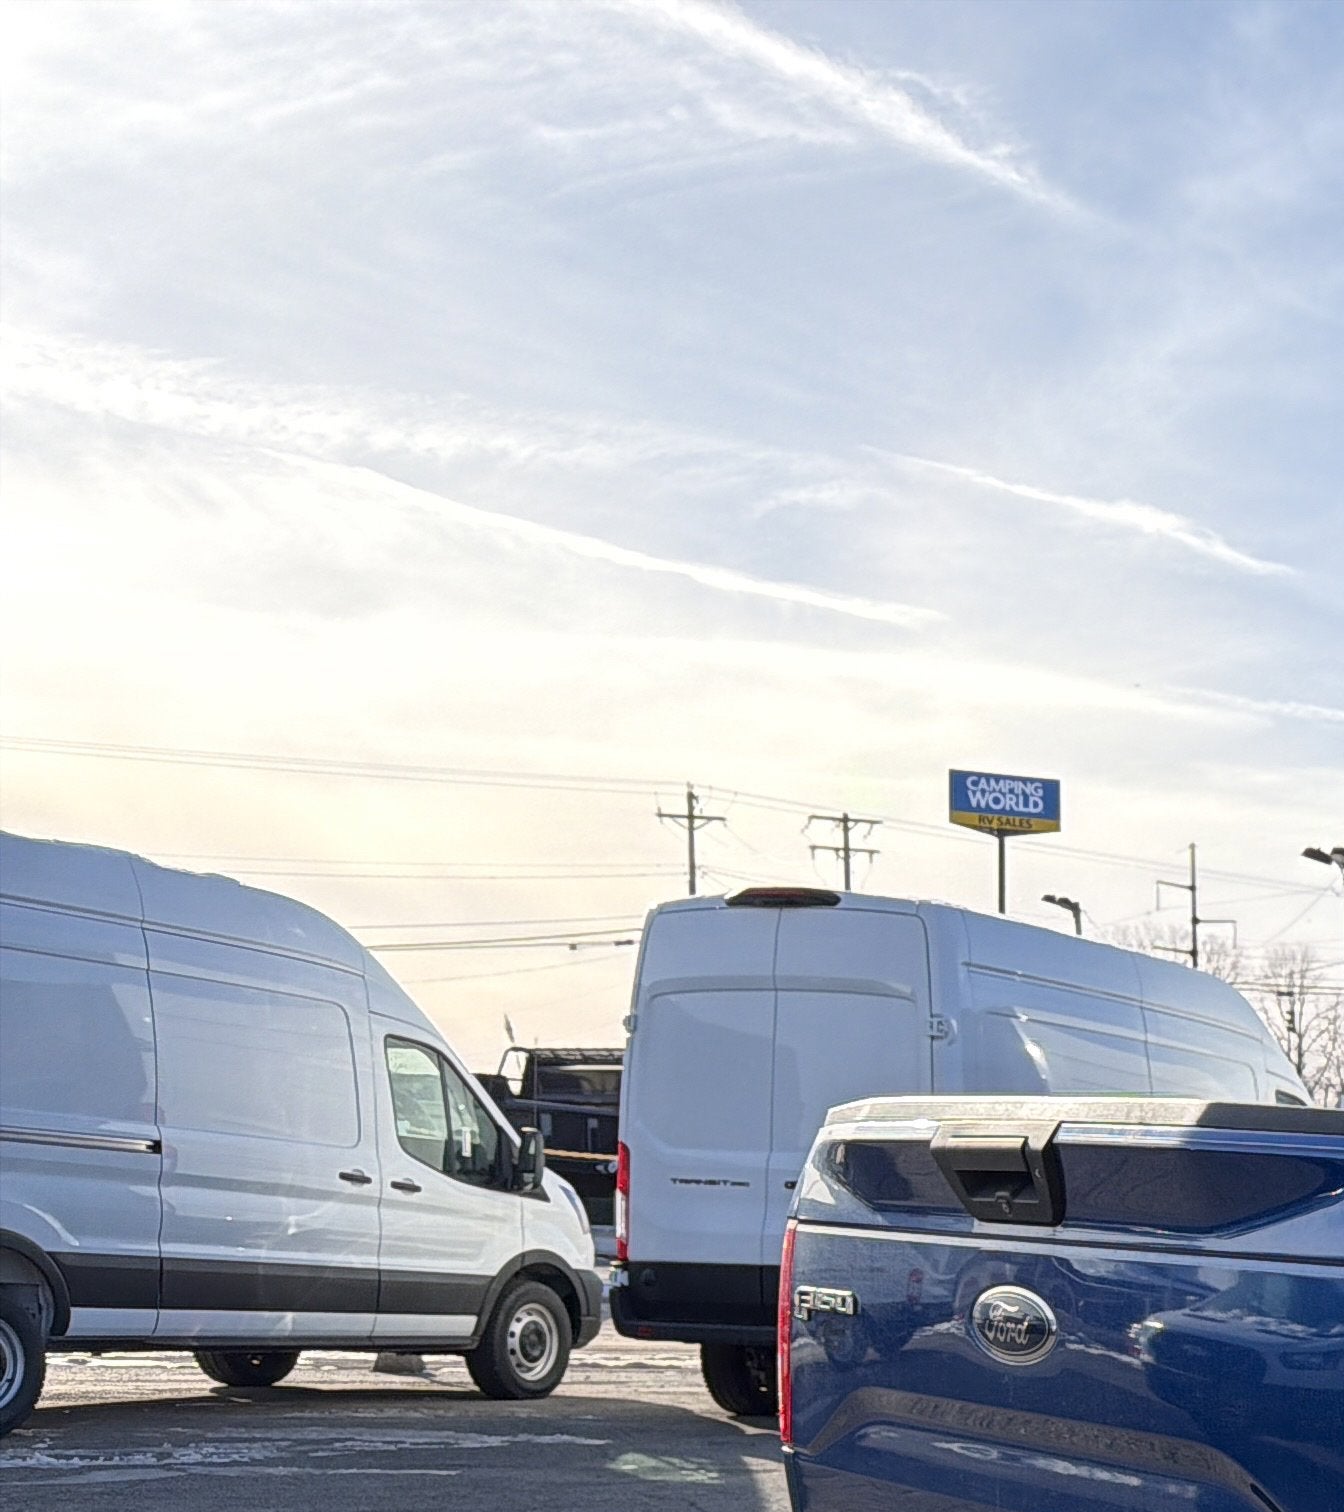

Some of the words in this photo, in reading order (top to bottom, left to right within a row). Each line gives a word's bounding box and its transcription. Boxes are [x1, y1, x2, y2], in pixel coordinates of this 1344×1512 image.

[966, 776, 1044, 797] CAMPING
[967, 789, 1044, 813] WORLD
[978, 815, 994, 826] RV
[995, 816, 1033, 829] SALES
[670, 1177, 730, 1187] TRANSIT
[984, 1300, 1030, 1345] Ford
